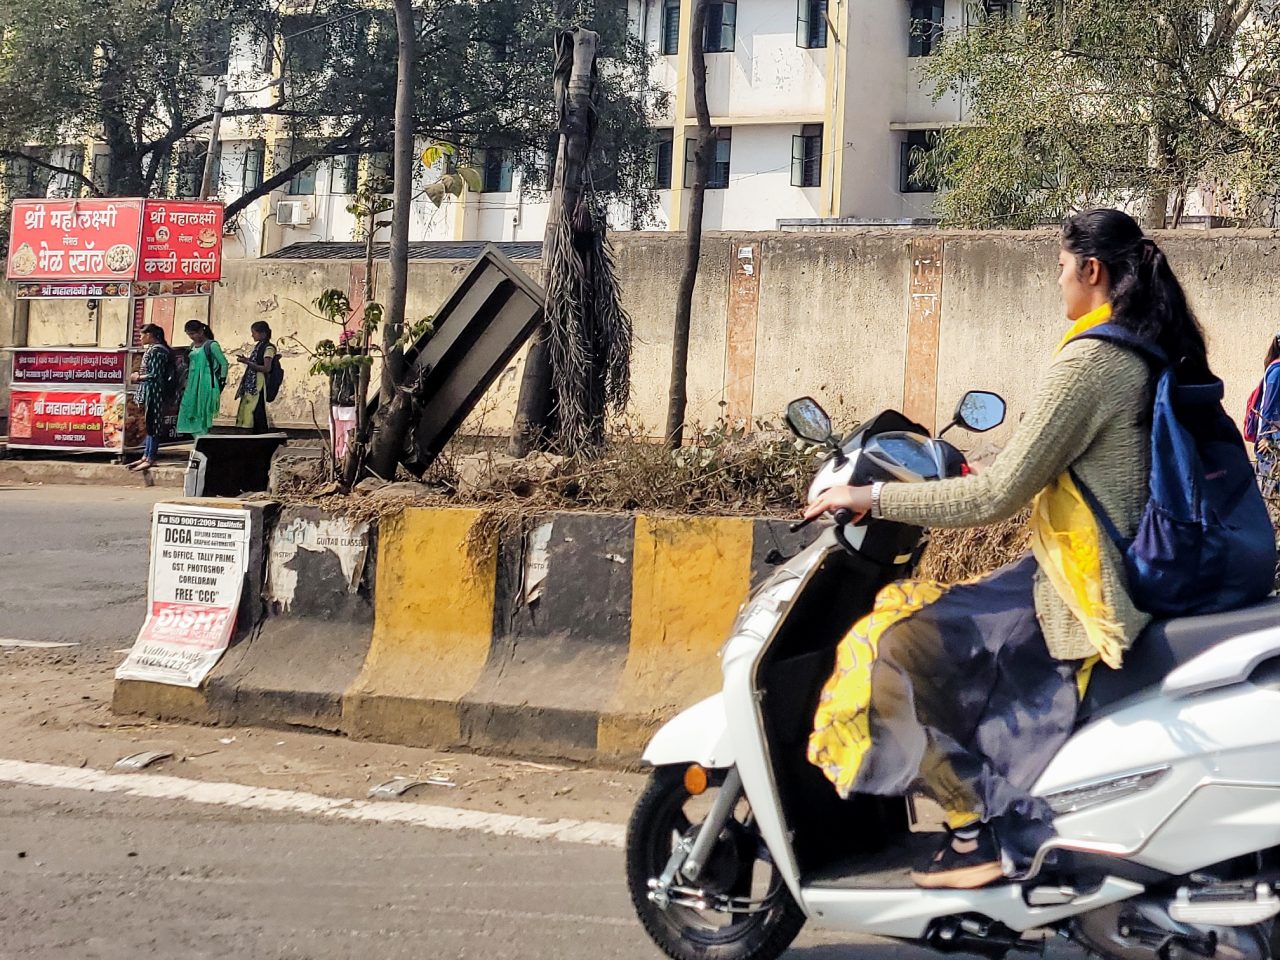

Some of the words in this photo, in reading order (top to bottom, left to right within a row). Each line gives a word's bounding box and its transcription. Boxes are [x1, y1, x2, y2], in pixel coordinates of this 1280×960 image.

[24, 204, 46, 229] श्री
[50, 204, 117, 231] महालक्ष्मी
[150, 207, 166, 224] श्री
[169, 210, 216, 226] महालक्ष्मी
[39, 241, 64, 271] भेळ
[69, 240, 105, 273] स्टॉल
[144, 252, 178, 273] कच्छी
[181, 252, 216, 275] दाबेली
[41, 285, 51, 296] श्री
[33, 400, 45, 415] श्री
[160, 515, 168, 523] An
[169, 516, 180, 525] ISO
[165, 527, 192, 544] DCGA
[316, 537, 338, 546] GUITAR
[340, 538, 366, 546] CLASSE
[163, 550, 172, 558] Ms
[197, 552, 214, 561] TALLY
[179, 575, 217, 586] CORELDRAW
[175, 588, 193, 601] FREE
